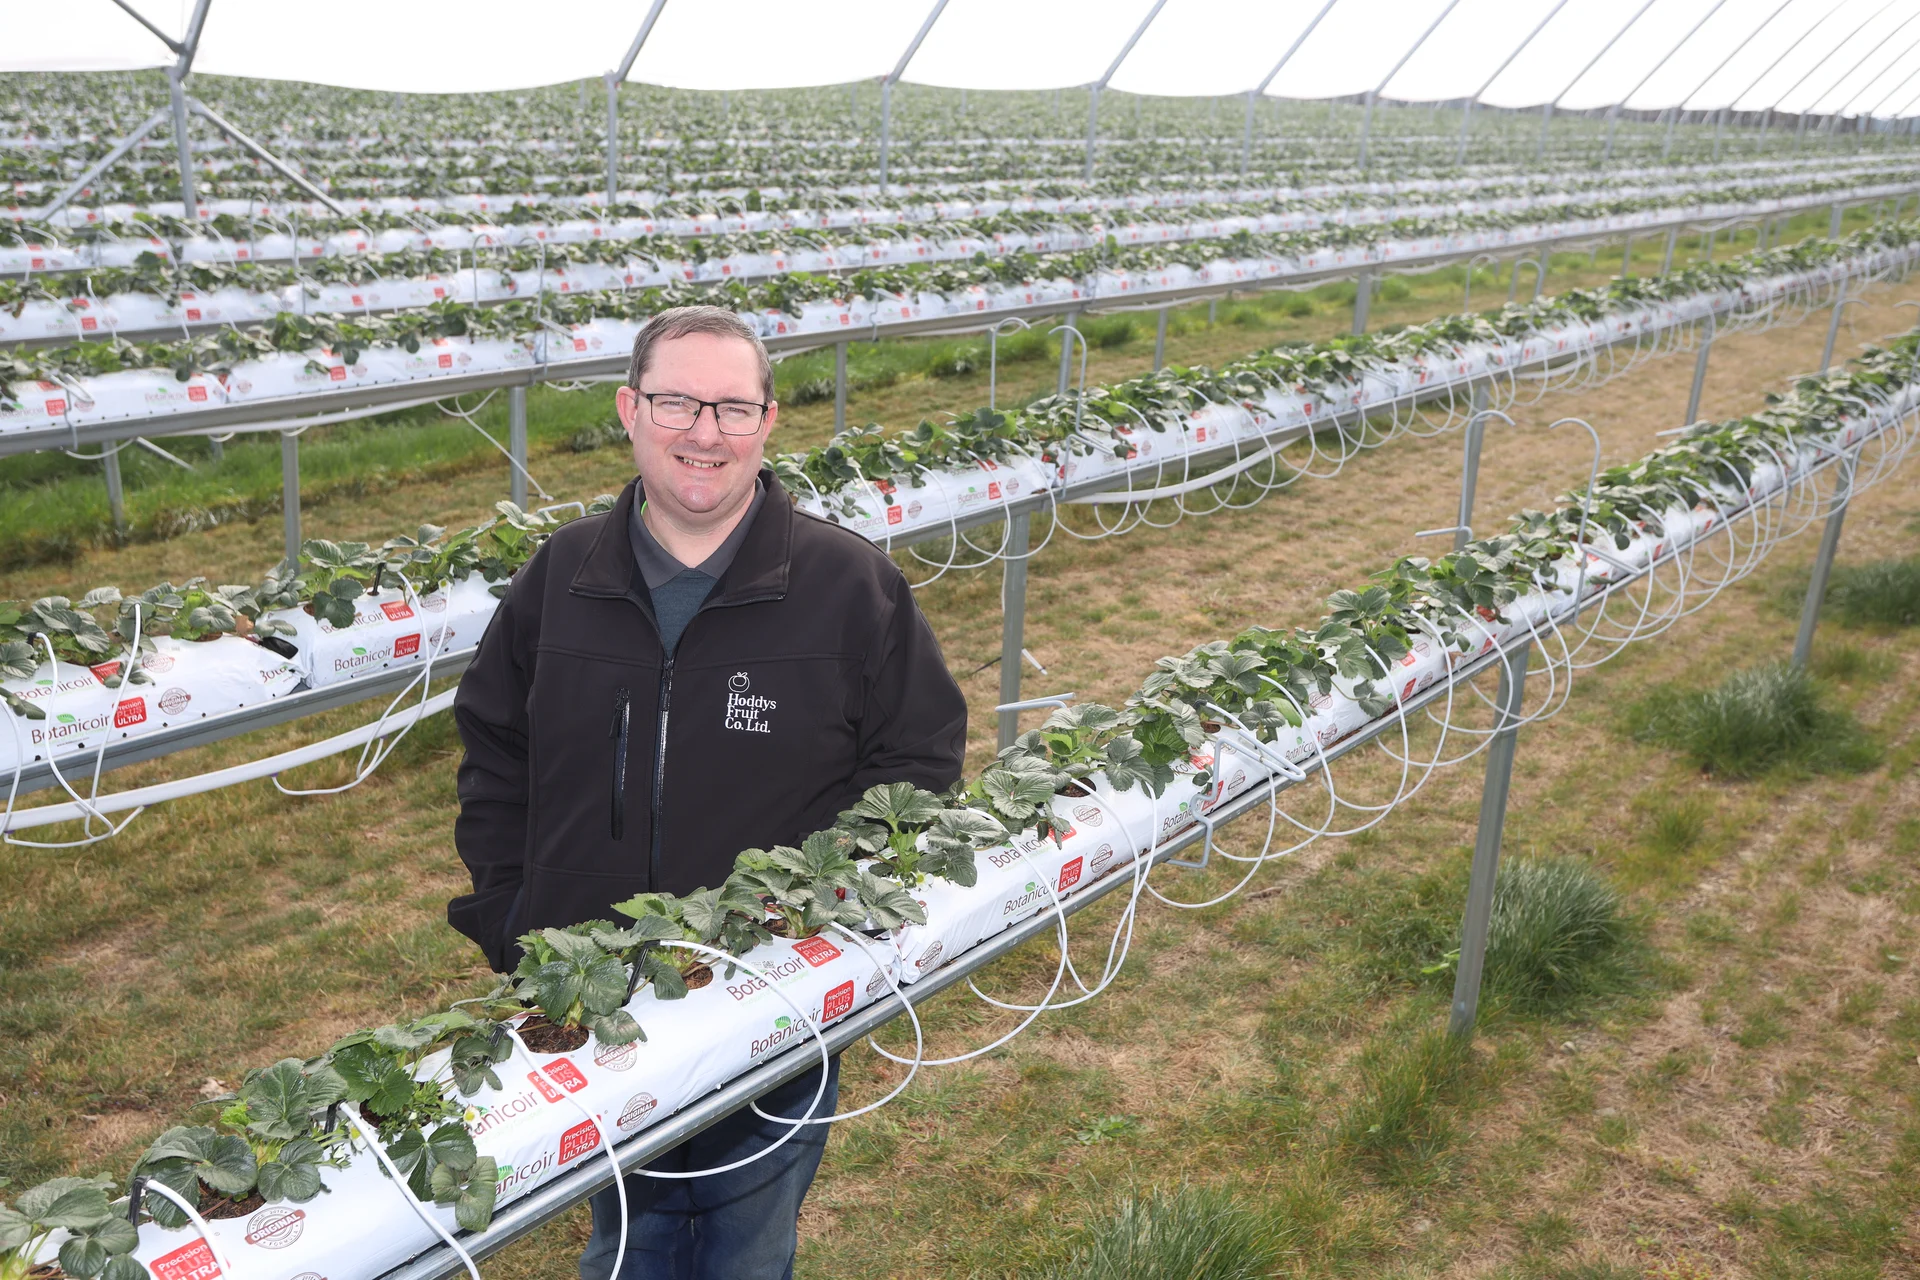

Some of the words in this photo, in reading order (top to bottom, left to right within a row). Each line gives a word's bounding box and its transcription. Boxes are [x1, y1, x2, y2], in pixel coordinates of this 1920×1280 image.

[321, 610, 384, 635] Bonicoir
[389, 610, 411, 620] ULTRA
[334, 646, 393, 672] Botanicoir
[395, 647, 416, 656] ULTRA
[117, 706, 143, 718] PLUS
[726, 704, 760, 719] Fruit
[727, 693, 777, 712] Hoddys
[117, 713, 144, 726] ULTRA
[724, 717, 744, 731] Co.
[745, 718, 771, 733] Ltd.
[1060, 874, 1078, 889] ULTRA
[1061, 867, 1080, 881] PLUS
[797, 939, 823, 951] Precision
[802, 942, 829, 957] PLUS
[809, 948, 837, 964] ULTRA
[726, 956, 805, 1001] Botanicoir
[826, 993, 851, 1012] PLUS
[827, 986, 852, 1002] Precision
[825, 1002, 850, 1019] ULTRA
[598, 1043, 634, 1065] ORIGINAL
[546, 1076, 582, 1099] URA
[473, 1091, 538, 1139] anicoir
[620, 1101, 654, 1124] ORIGINAL
[562, 1139, 595, 1161] ULTRA
[564, 1129, 597, 1153] PLUS
[495, 1151, 556, 1195] anicoir
[250, 1213, 301, 1242] ORIGINAL
[157, 1243, 208, 1272] Precision
[163, 1251, 214, 1280] PLUS
